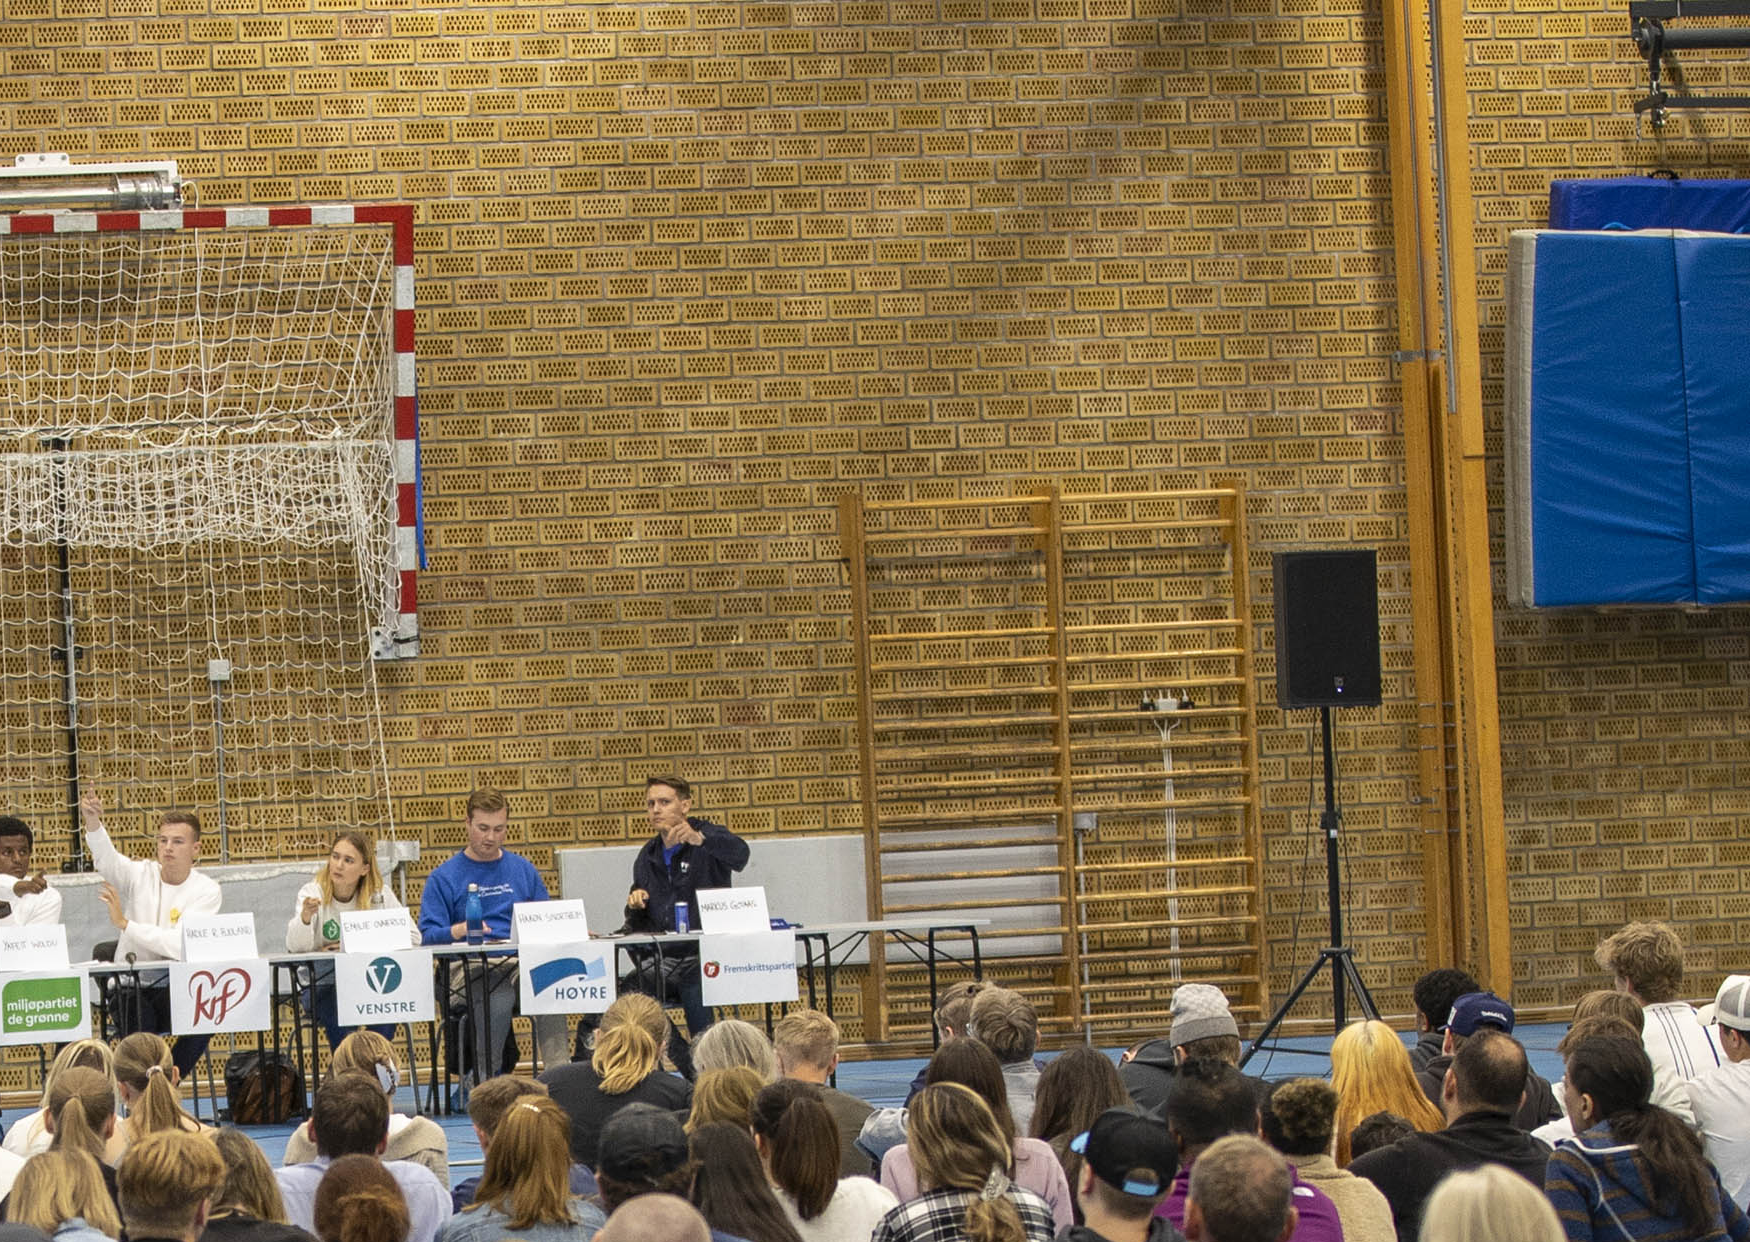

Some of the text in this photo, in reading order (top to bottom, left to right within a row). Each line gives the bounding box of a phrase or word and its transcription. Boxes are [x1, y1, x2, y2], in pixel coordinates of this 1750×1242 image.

[723, 962, 795, 974] Fremskrittspartiet
[555, 986, 607, 1000] HØYRE
[6, 996, 78, 1013] miljøpartiet
[356, 1001, 416, 1015] VENSTRE
[7, 1012, 70, 1028] de grønne
